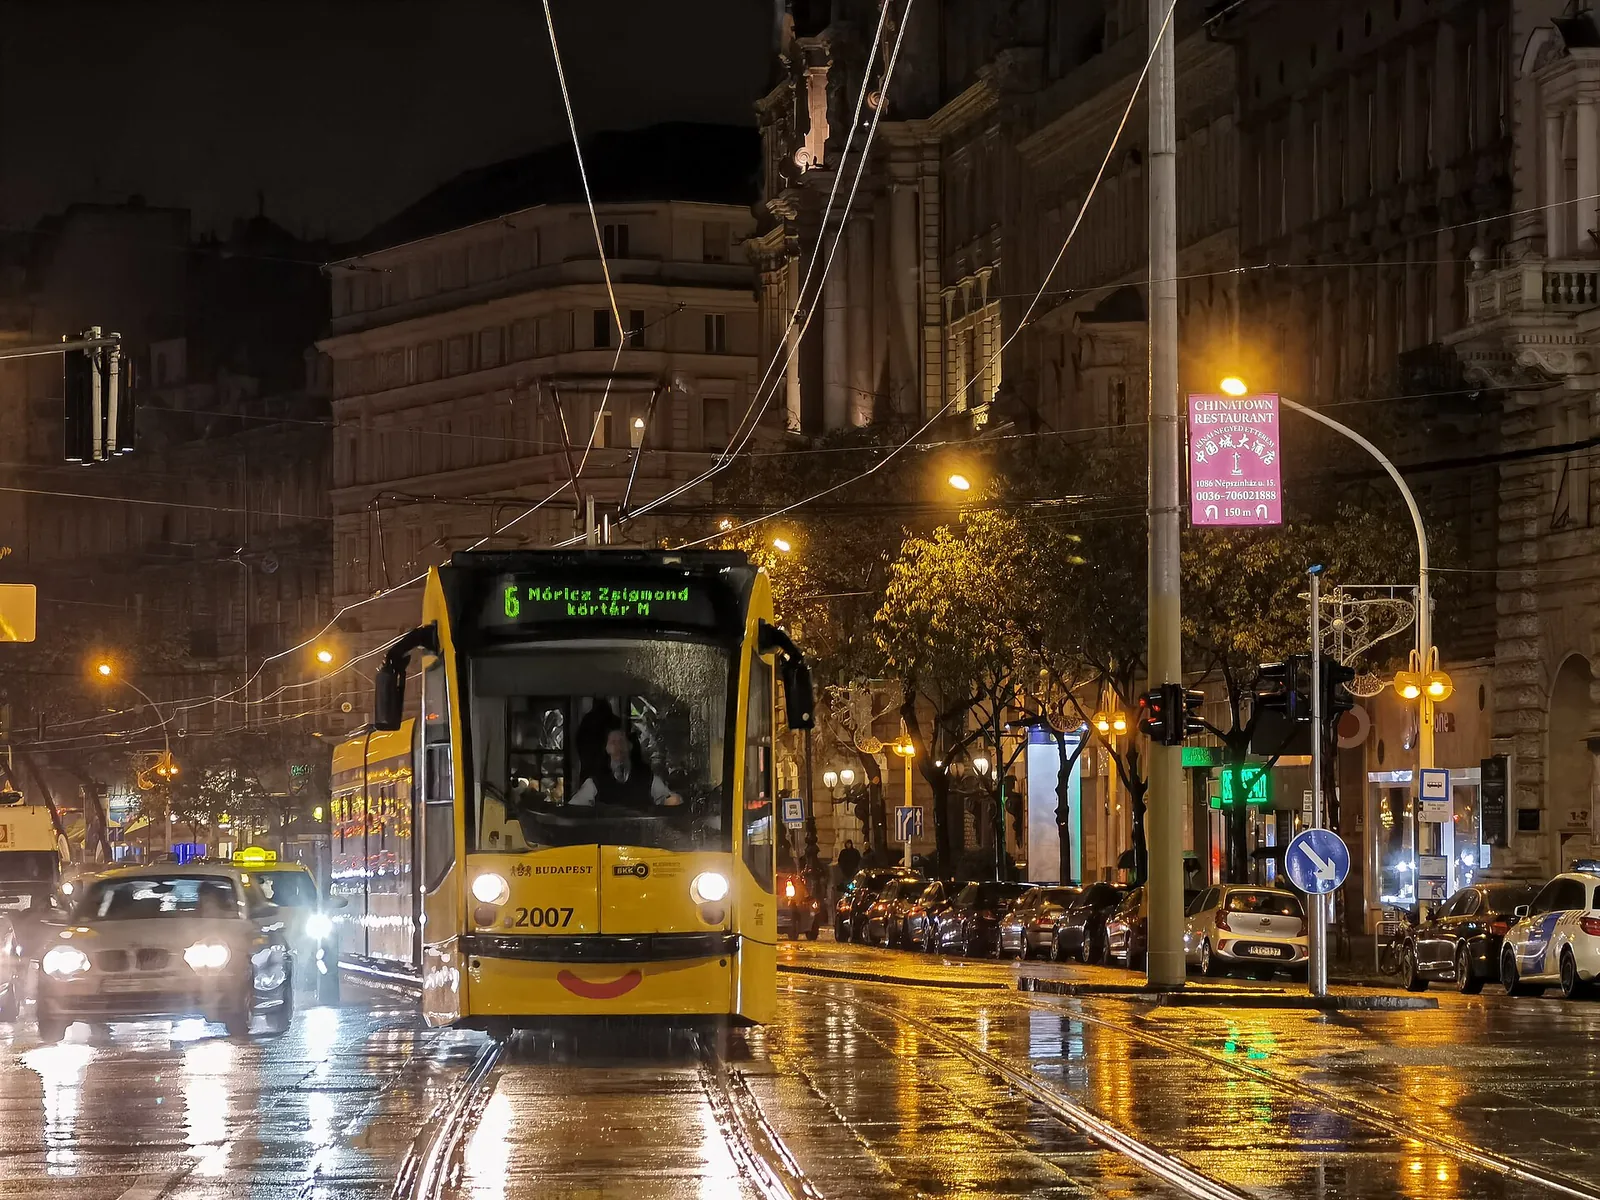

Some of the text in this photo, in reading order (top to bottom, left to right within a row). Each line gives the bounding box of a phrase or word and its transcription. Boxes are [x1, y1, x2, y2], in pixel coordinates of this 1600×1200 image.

[1194, 400, 1273, 411] CHINATOWN
[1194, 413, 1275, 424] RESTAURANT
[1196, 480, 1213, 488] 1086
[1196, 491, 1276, 501] 0036-706021888
[1224, 507, 1241, 517] 150
[528, 586, 689, 602] Móricz Zsigmond
[504, 586, 520, 618] 6
[637, 602, 650, 616] M
[535, 865, 594, 875] BUDAPEST
[515, 907, 574, 928] 2007
